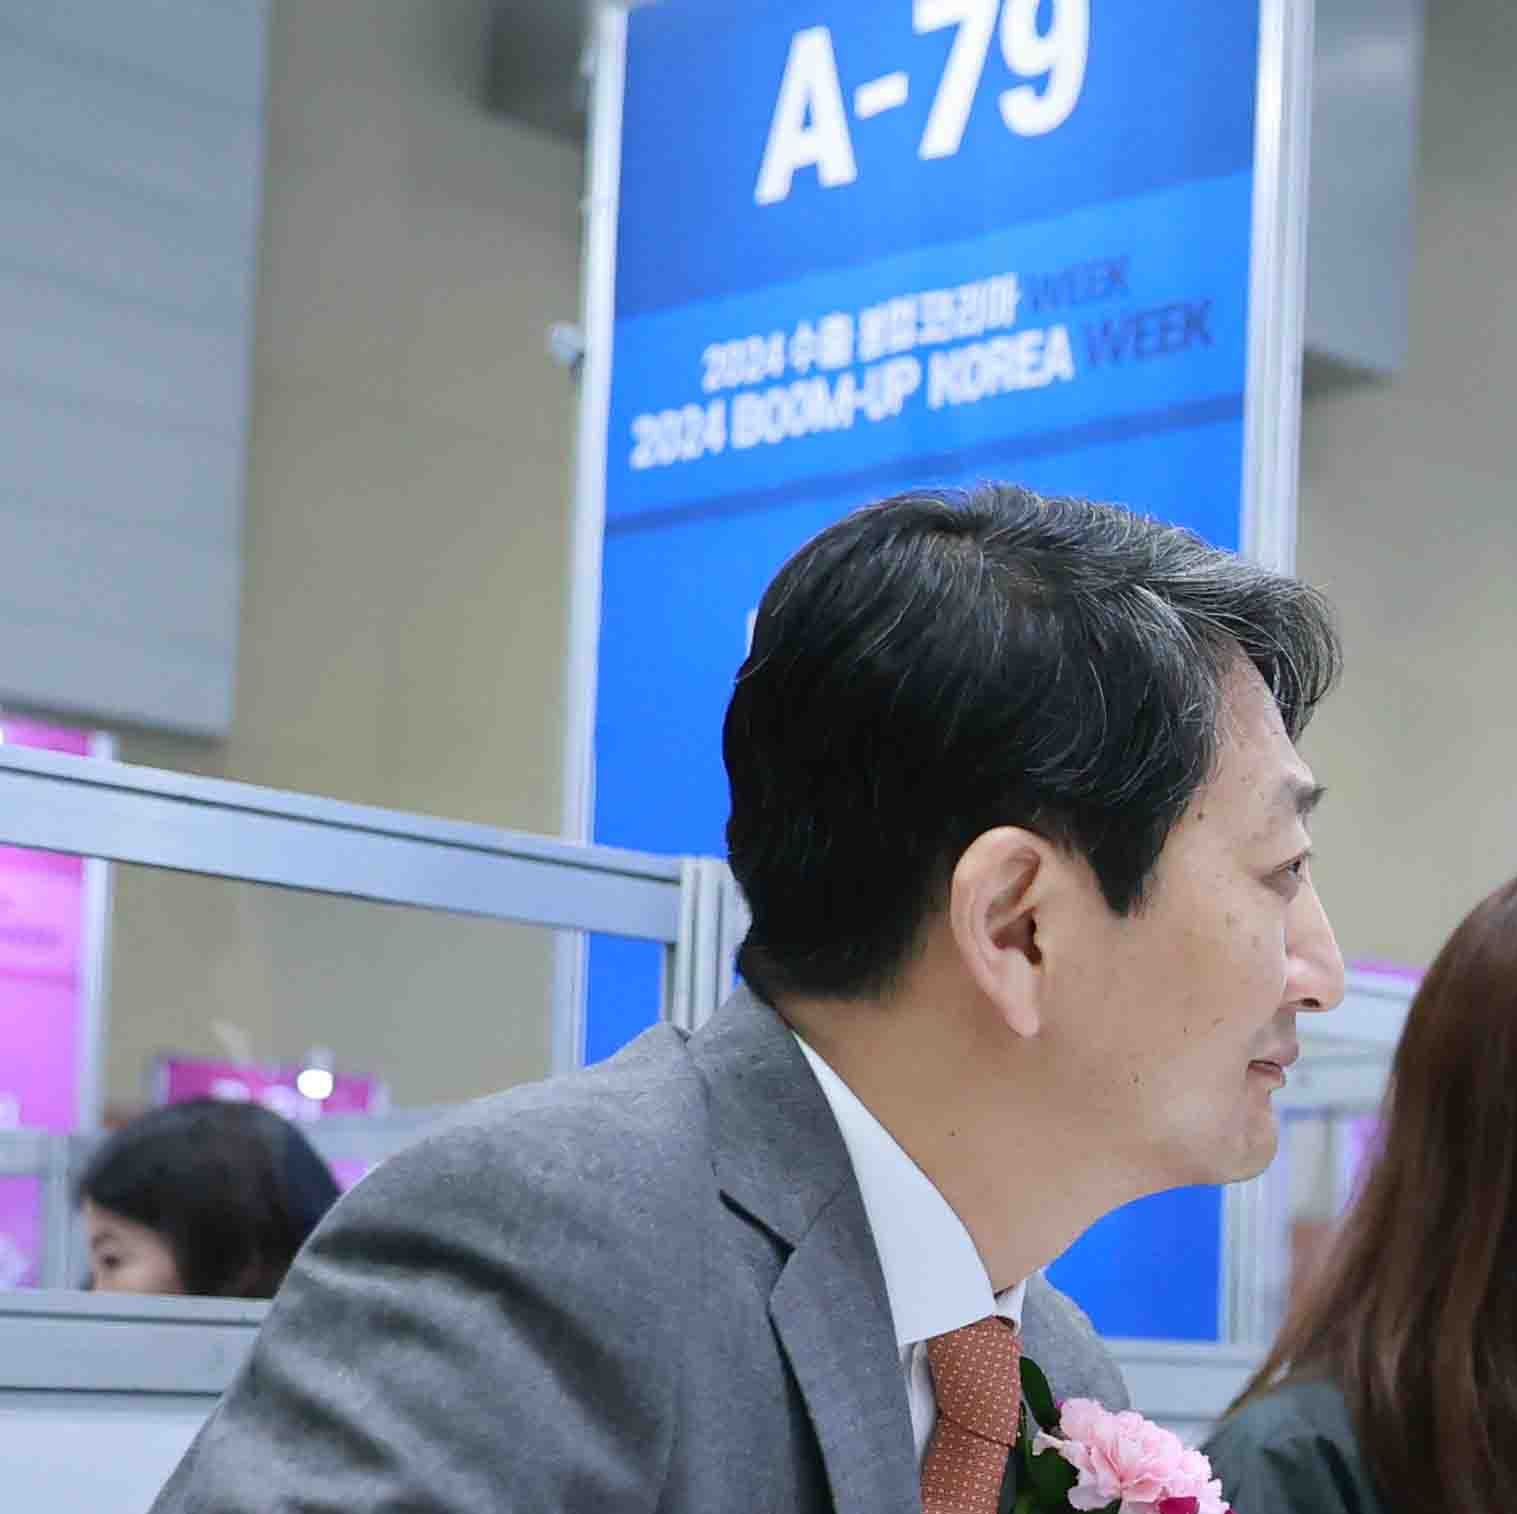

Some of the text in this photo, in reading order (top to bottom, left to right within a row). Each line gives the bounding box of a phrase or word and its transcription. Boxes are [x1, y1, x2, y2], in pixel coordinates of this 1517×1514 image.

[755, 0, 1089, 204] A-79
[630, 299, 1216, 469] 2024 BOOM-UP KOREA WEEK
